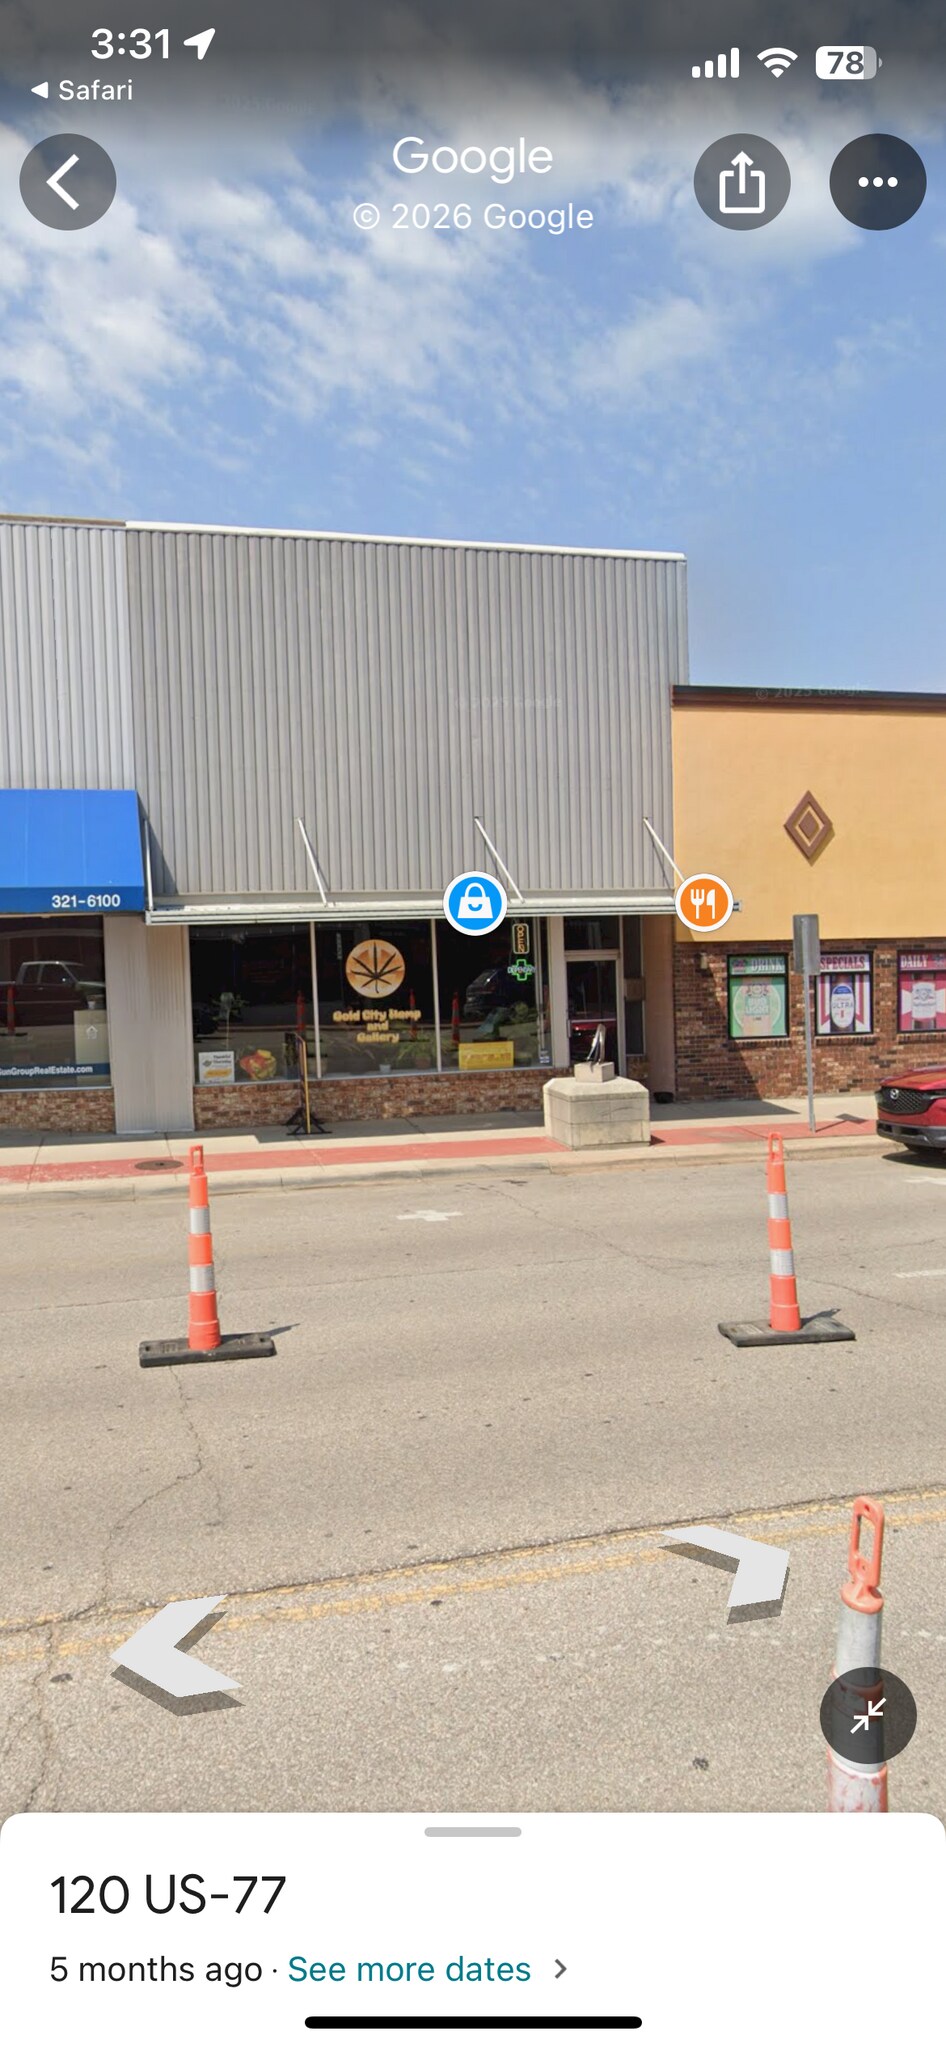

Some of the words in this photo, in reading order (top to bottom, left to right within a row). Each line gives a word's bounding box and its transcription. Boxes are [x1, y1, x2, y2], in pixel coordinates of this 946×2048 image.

[52, 894, 121, 908] 321-6100
[751, 957, 786, 973] DRINK
[820, 956, 865, 969] SPECIALS
[900, 954, 928, 969] DAILY
[832, 1001, 854, 1009] ULTRA
[333, 1009, 361, 1022] Gold
[361, 1008, 387, 1022] City
[388, 1008, 421, 1021] Hemp
[366, 1020, 389, 1032] and
[356, 1031, 399, 1043] Gallery
